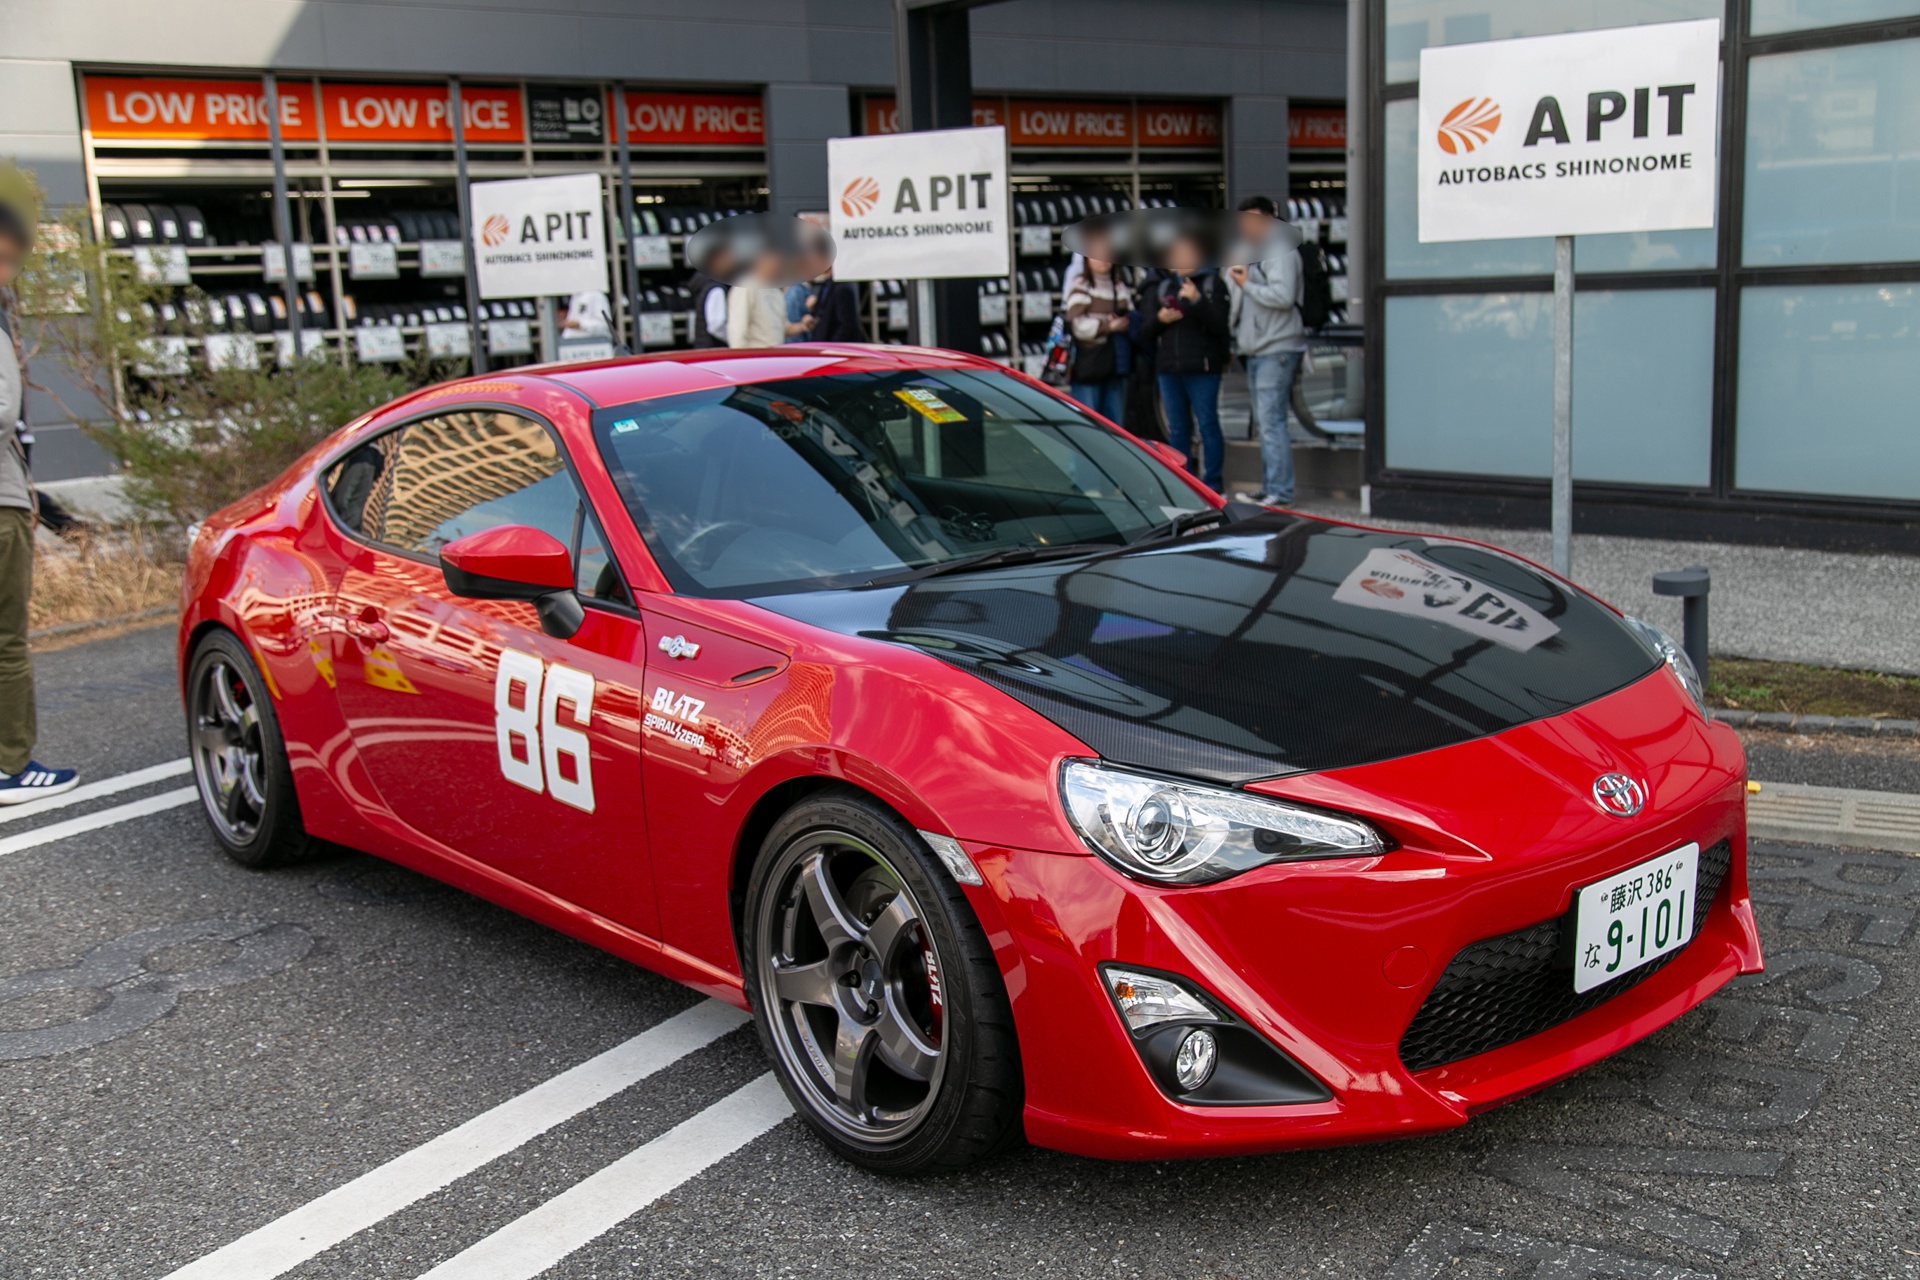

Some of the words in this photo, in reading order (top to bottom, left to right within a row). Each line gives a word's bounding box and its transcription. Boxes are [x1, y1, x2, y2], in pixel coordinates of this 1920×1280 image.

[105, 90, 195, 124] LOW
[338, 97, 418, 128] LOW
[624, 103, 687, 133] LOW
[692, 105, 763, 133] PRICE
[1020, 111, 1070, 136] LOW
[1074, 112, 1126, 137] PRICE
[1522, 95, 1571, 148] A
[1586, 83, 1696, 143] PIT
[1146, 112, 1192, 137] LOW
[1437, 163, 1547, 186] AUTOBACS
[1555, 152, 1693, 178] SHINONOME
[893, 176, 921, 214] A
[929, 171, 992, 212] PIT
[520, 214, 540, 244] A
[545, 210, 592, 242] PIT
[842, 225, 909, 240] AUTOBACS
[913, 221, 994, 237] SHINONOME
[484, 251, 533, 265] AUTOBACS
[535, 249, 594, 264] SHINONOME
[651, 686, 705, 724] BLITZ
[494, 646, 596, 814] 86
[1609, 877, 1643, 914] 藤沢
[1645, 864, 1674, 899] 386
[1584, 943, 1601, 968] な
[1605, 889, 1686, 973] 9-101
[924, 950, 943, 1006] BLITZ
